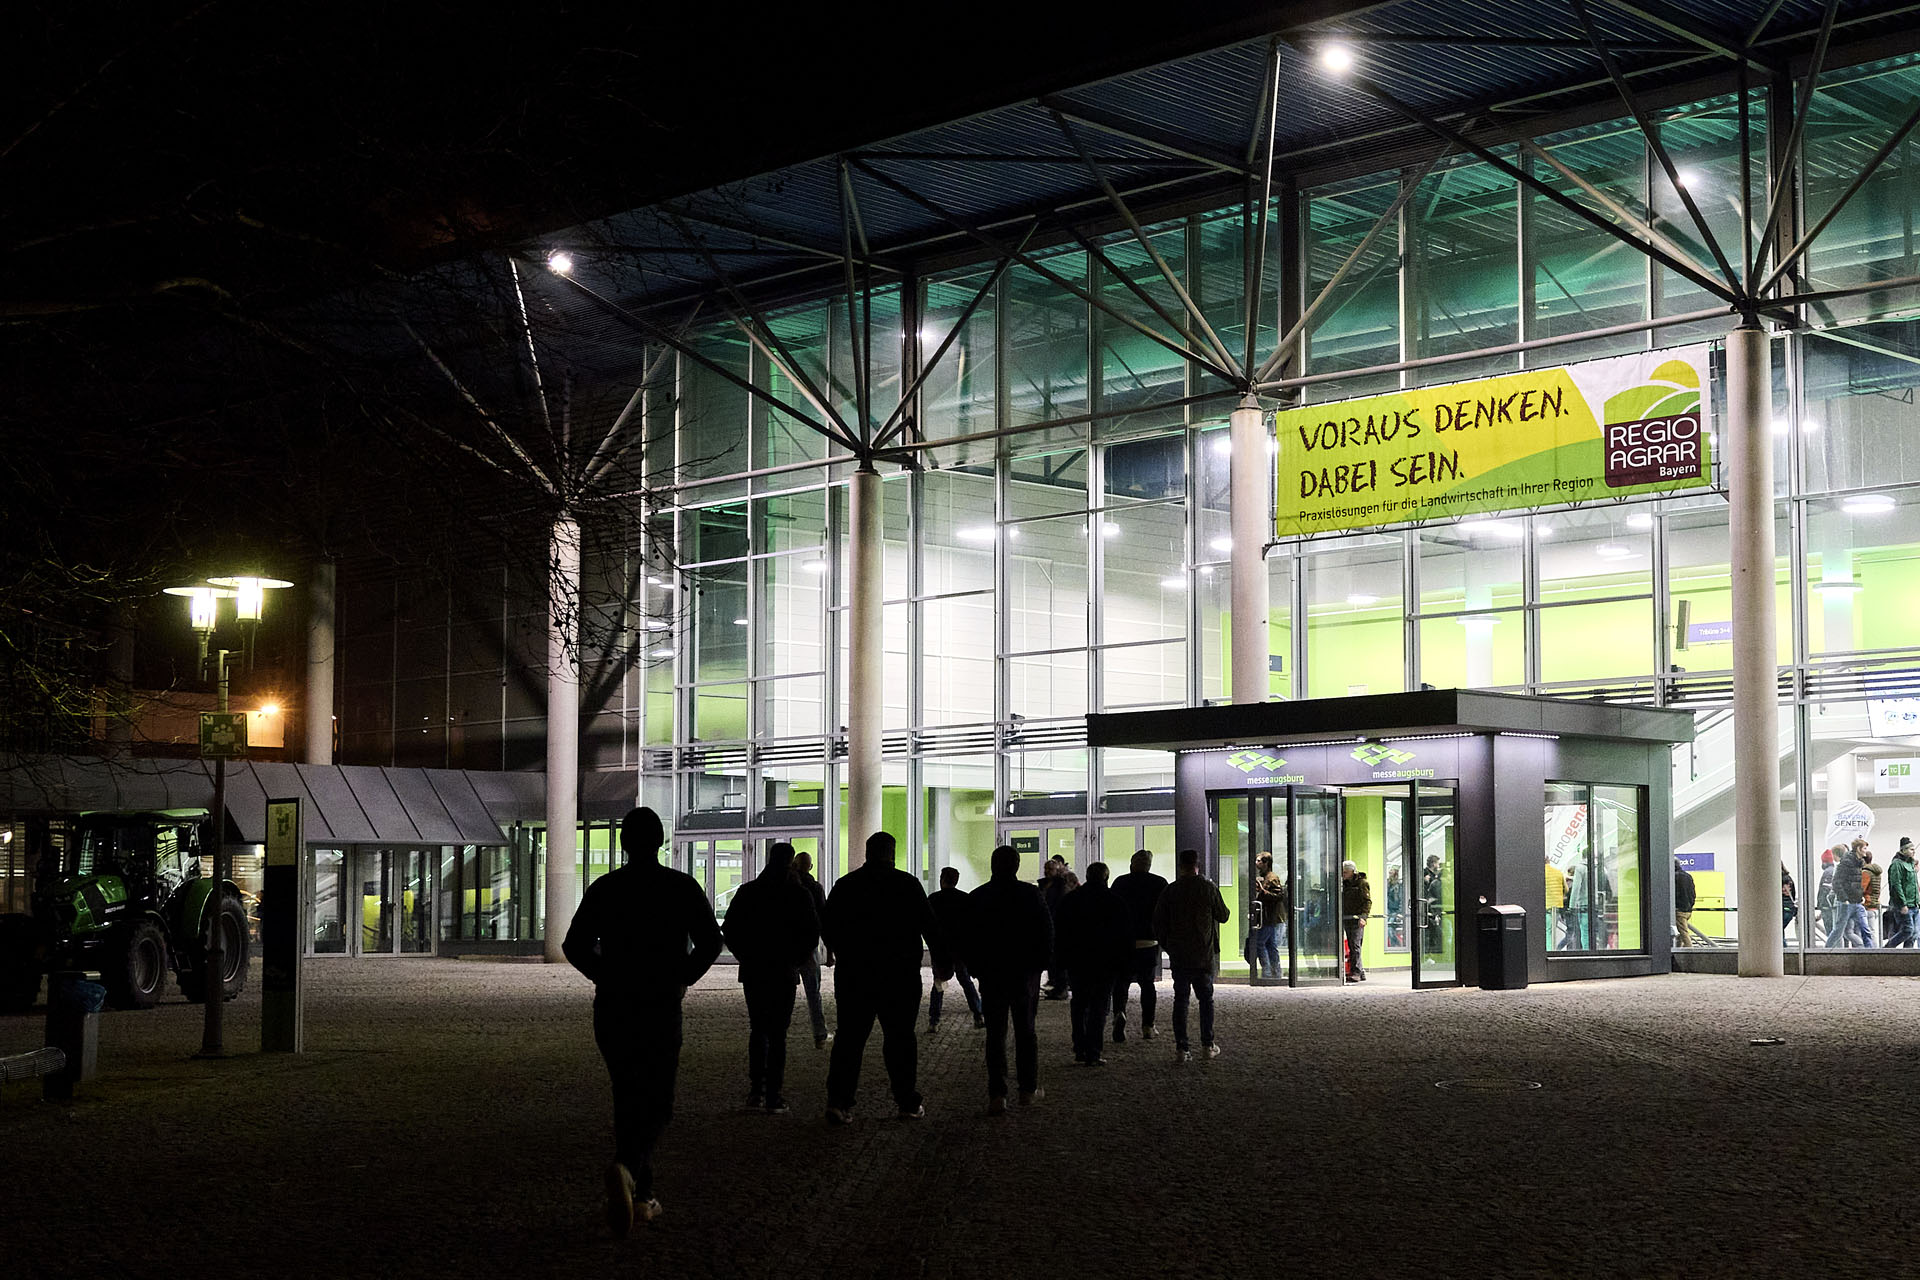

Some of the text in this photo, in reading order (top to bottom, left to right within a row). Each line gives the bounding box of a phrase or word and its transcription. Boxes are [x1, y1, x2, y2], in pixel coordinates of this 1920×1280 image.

[1299, 386, 1569, 451] VORAUS DENKEN.
[1610, 417, 1698, 449] REGIO
[1610, 441, 1696, 470] AGRAR
[1300, 449, 1465, 499] DABEI SEIN.
[1659, 464, 1697, 478] Bayern
[1299, 476, 1594, 522] Praxislösungen für die Landwirtschaft in Ihrer Region
[1247, 774, 1305, 785] messeaugsburg
[1372, 768, 1434, 778] messeaugsburg
